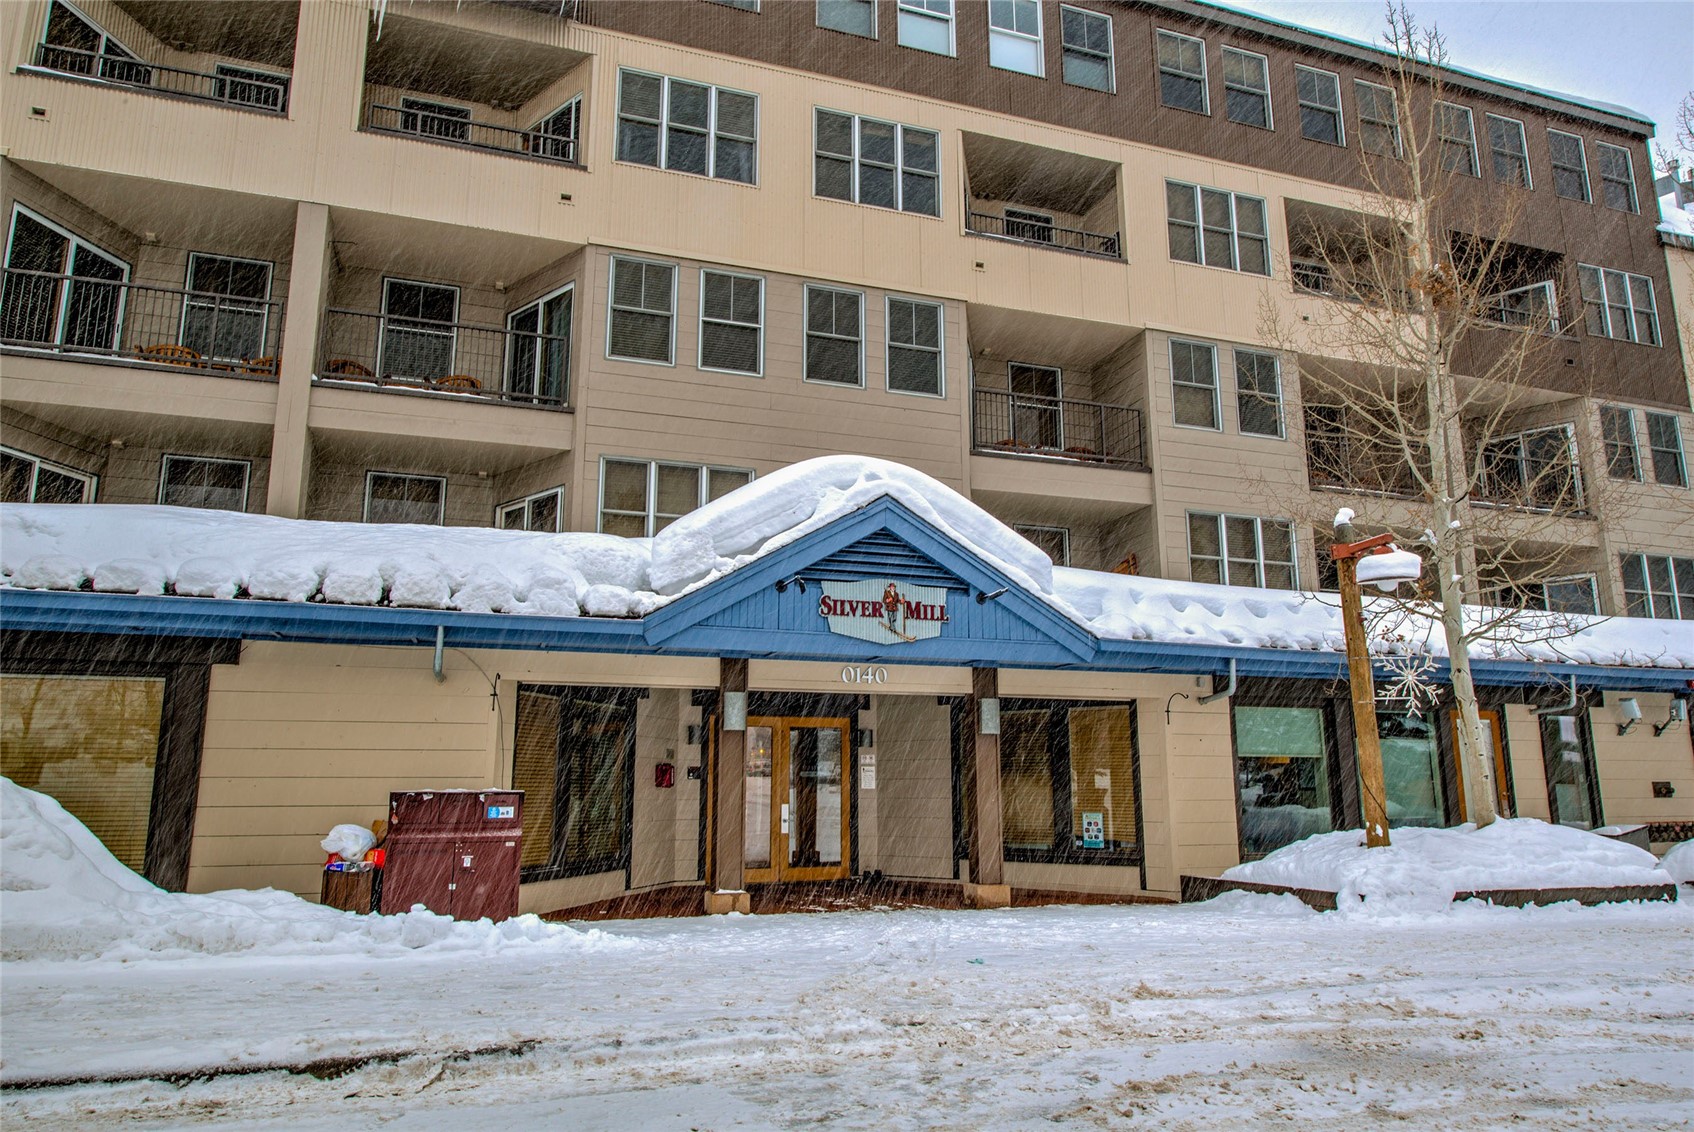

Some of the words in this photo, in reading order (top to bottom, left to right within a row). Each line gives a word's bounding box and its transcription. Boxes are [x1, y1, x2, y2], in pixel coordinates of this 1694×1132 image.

[820, 595, 884, 618] SILVER
[904, 601, 949, 621] MILL
[841, 666, 888, 684] 0140
